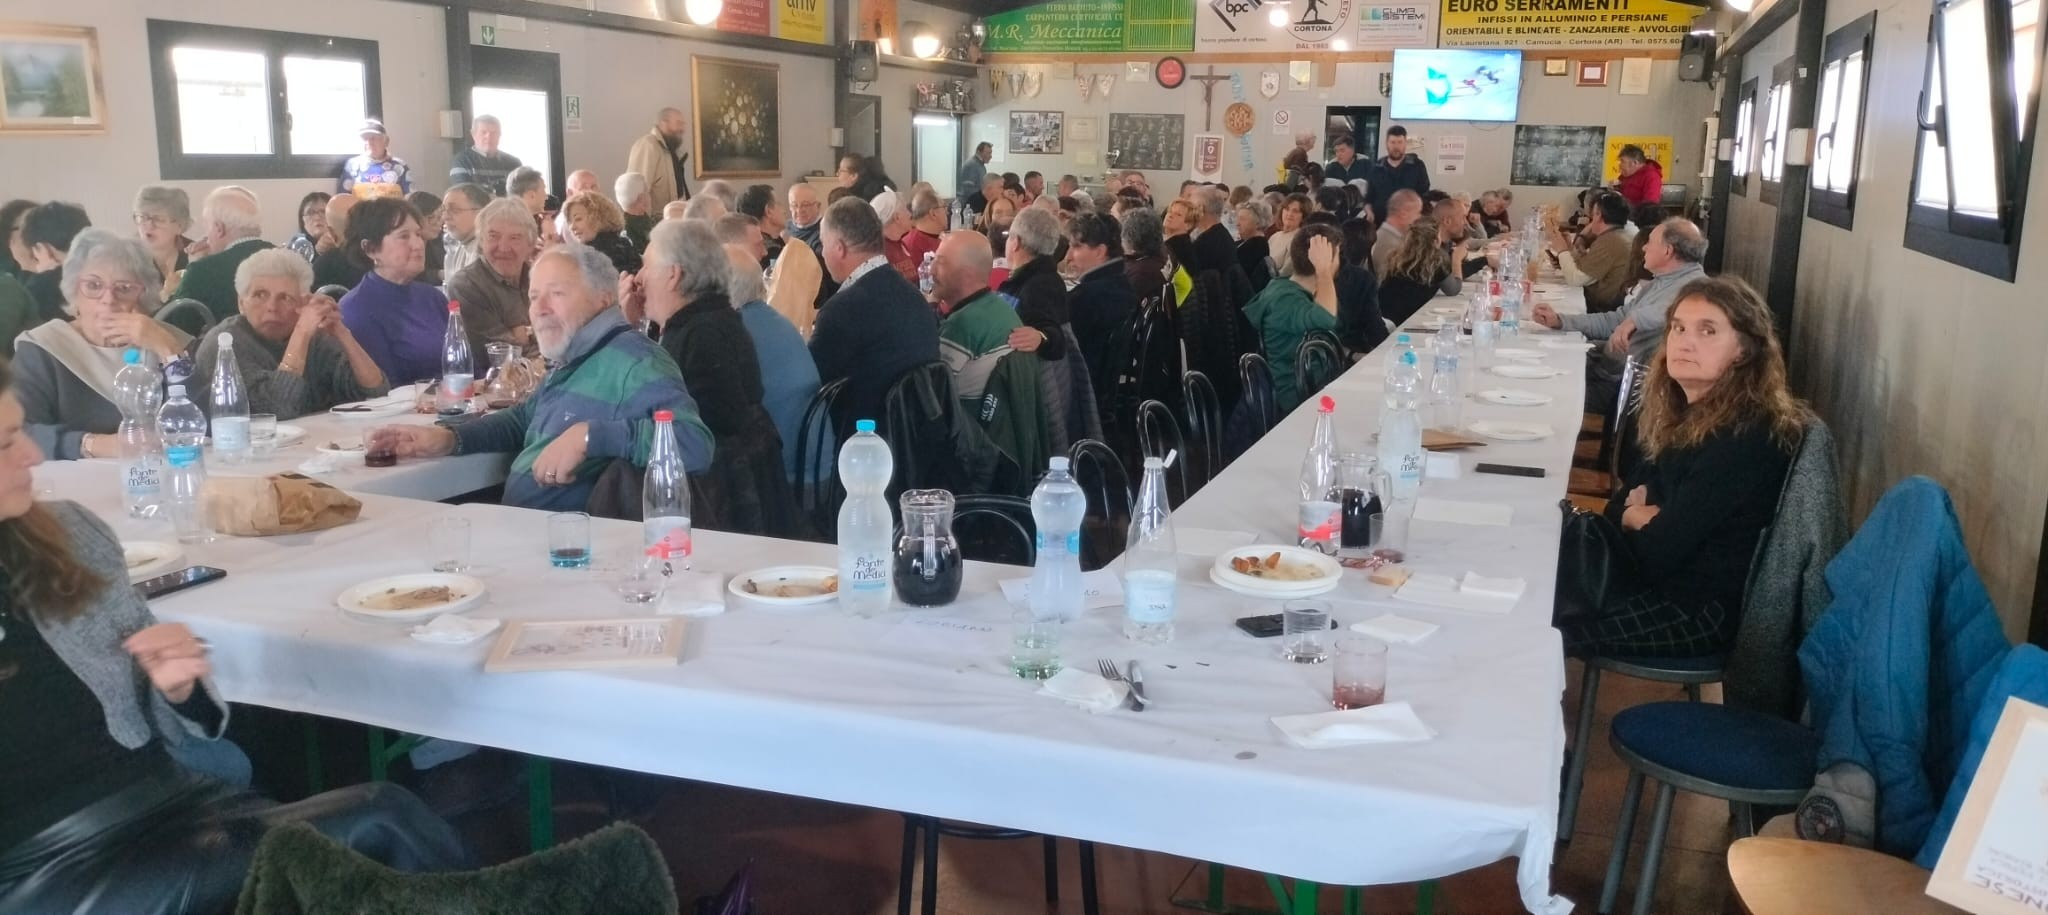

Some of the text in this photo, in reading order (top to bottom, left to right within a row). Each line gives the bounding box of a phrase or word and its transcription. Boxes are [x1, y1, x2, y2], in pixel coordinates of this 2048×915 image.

[1225, 0, 1248, 17] bpc
[1447, 0, 1629, 12] EURO SERRAMENTI
[1536, 14, 1597, 22] ALLUMINIO
[1029, 22, 1122, 39] Meccanica
[1446, 27, 1504, 35] ORIENTABILI
[1515, 26, 1561, 34] BLINDATE
[1569, 26, 1630, 34] ZANZARIERE
[1604, 38, 1623, 46] (AR)
